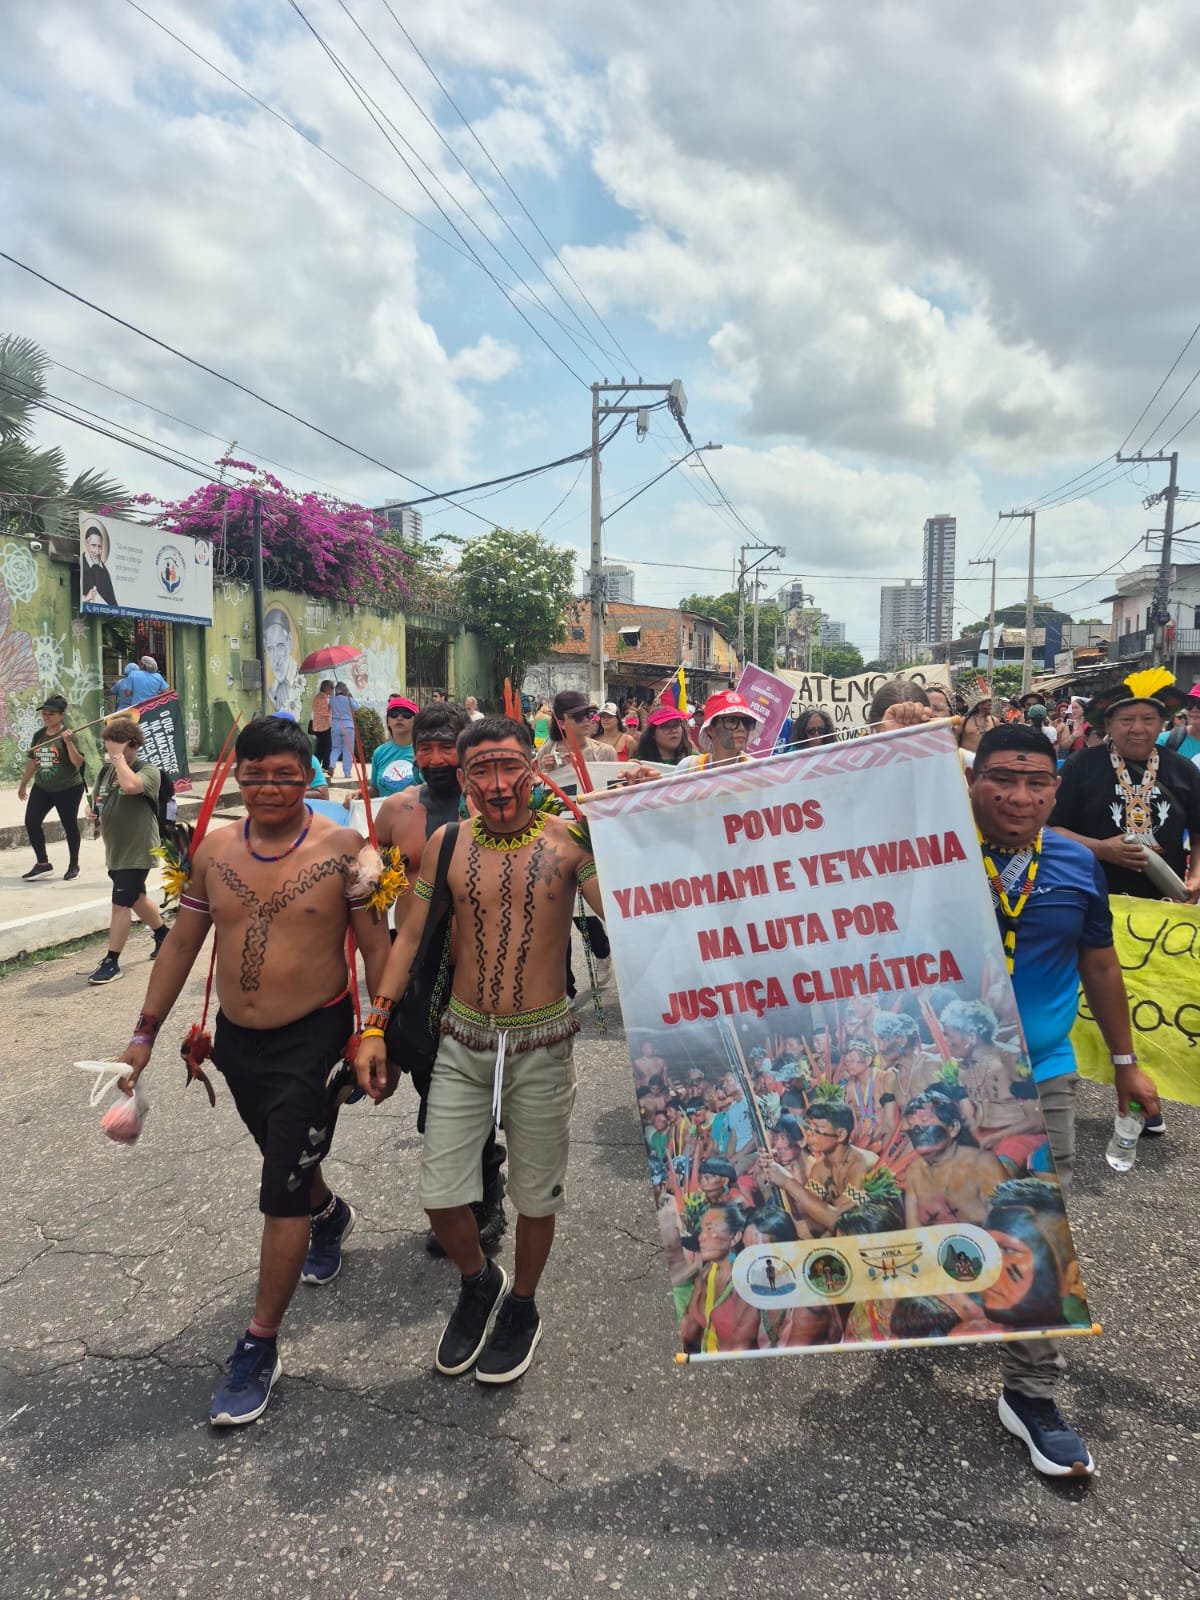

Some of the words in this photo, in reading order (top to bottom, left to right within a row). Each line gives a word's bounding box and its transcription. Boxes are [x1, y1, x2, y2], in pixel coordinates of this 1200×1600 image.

[159, 710, 171, 718] O
[834, 704, 853, 722] DA
[150, 719, 162, 733] NA
[160, 717, 175, 734] QUE
[144, 737, 157, 757] FICA
[723, 799, 824, 845] POVOS
[613, 865, 769, 919] YANOMAMI
[774, 861, 796, 891] E
[798, 831, 967, 888] YE'KWANA
[697, 930, 744, 961] NA
[747, 913, 829, 954] LUTA
[832, 901, 898, 939] POR
[662, 977, 789, 1025] JUSTIÇA
[792, 950, 963, 1004] CLIMÁTICA
